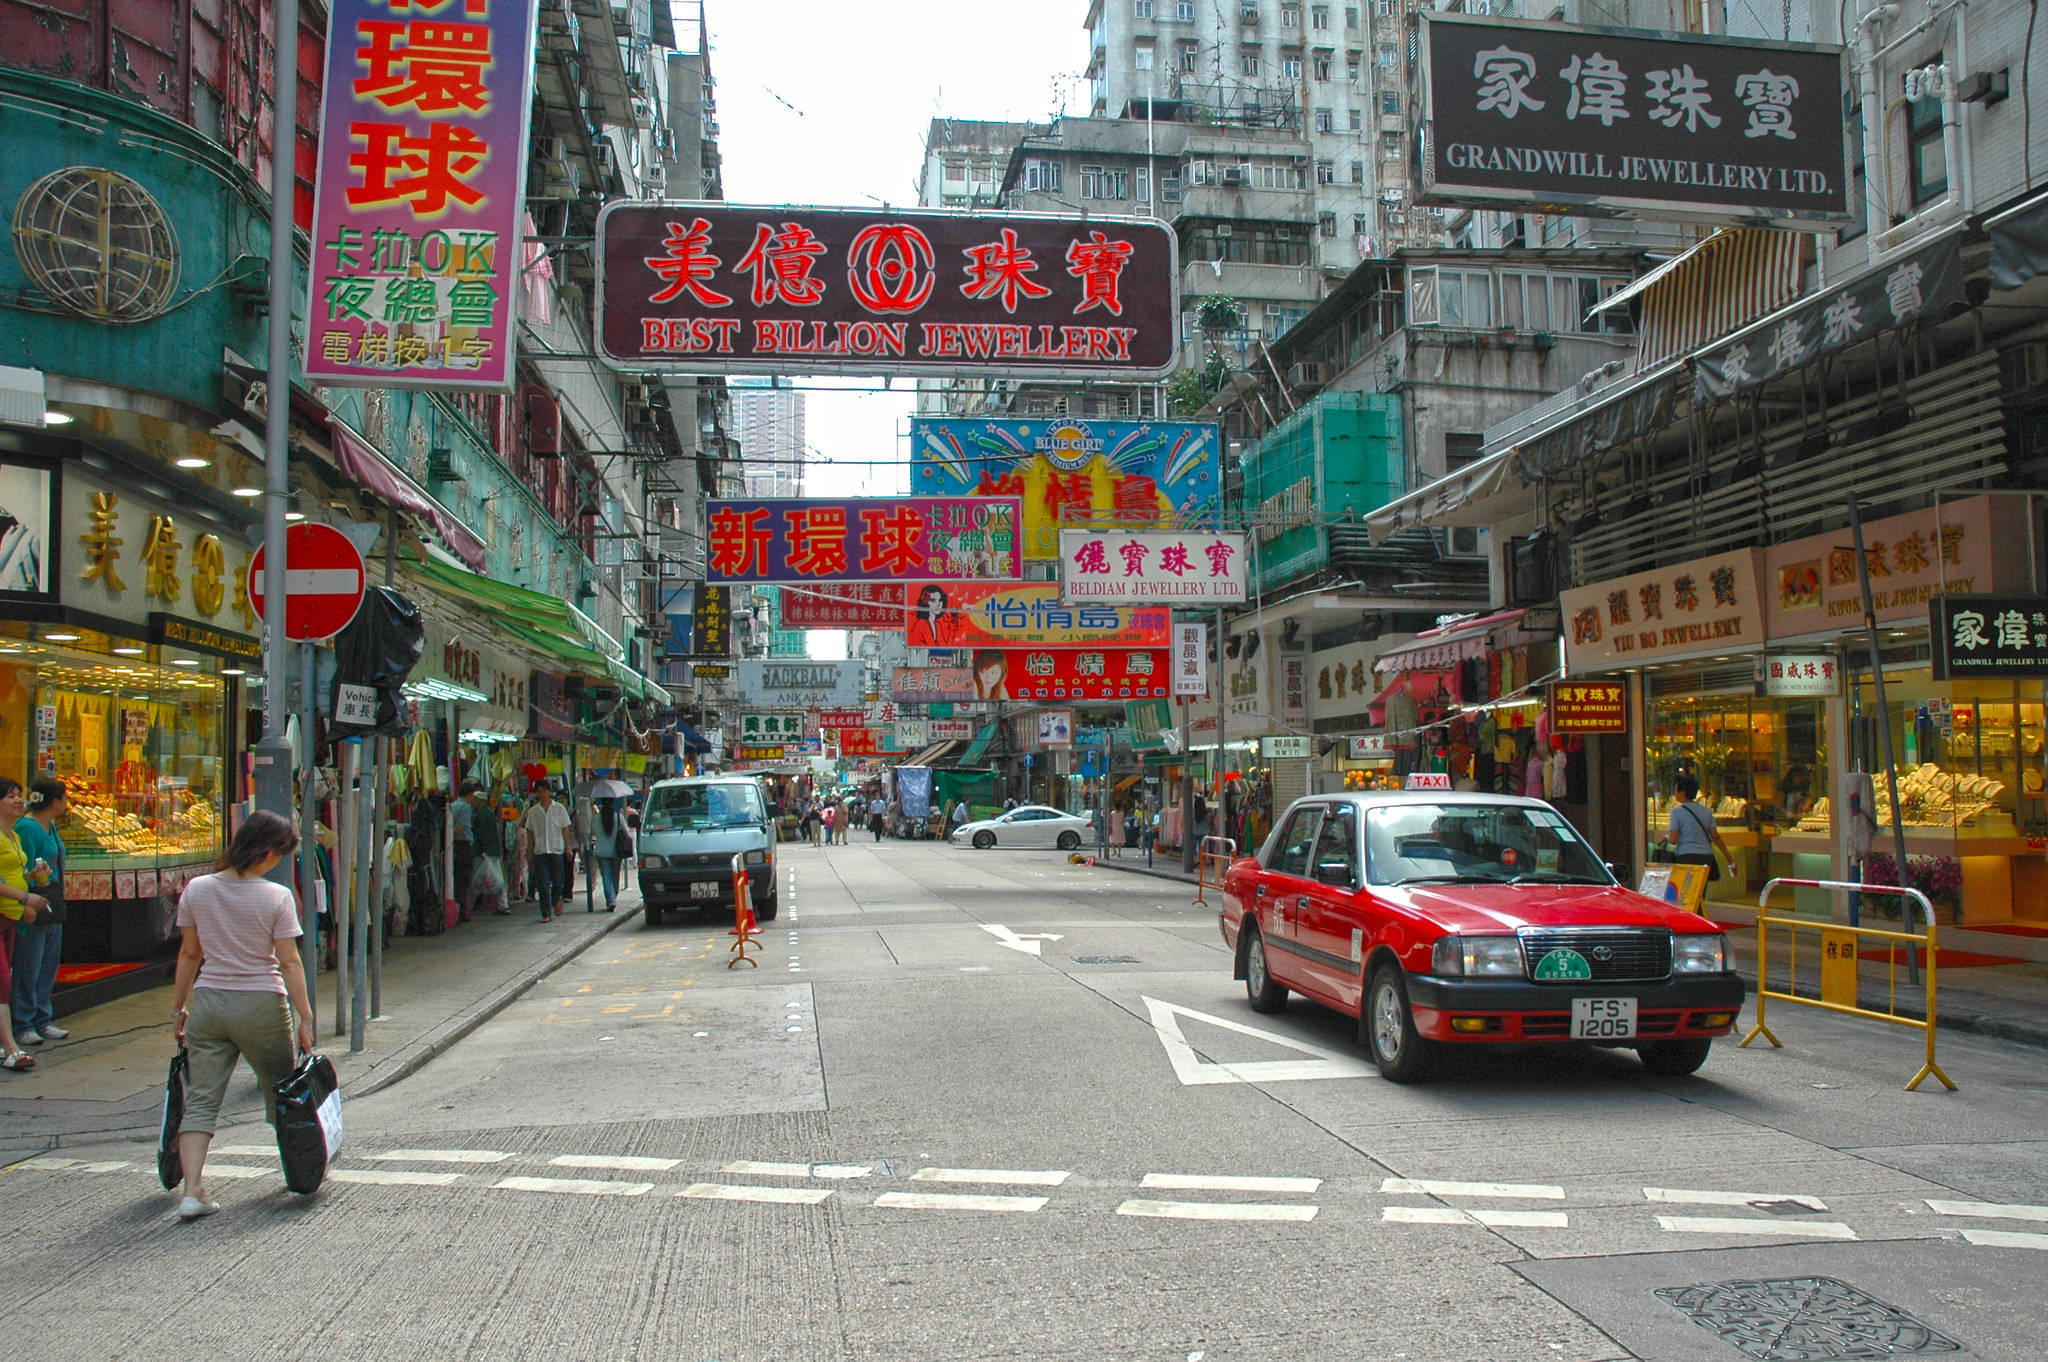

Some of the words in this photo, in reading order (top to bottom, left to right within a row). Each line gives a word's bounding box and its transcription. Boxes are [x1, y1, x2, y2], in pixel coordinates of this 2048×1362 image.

[346, 0, 494, 215] 環球
[1473, 44, 1800, 142] 家偉珠寶
[1446, 143, 1612, 180] GRANDWILL
[1618, 155, 1773, 191] JEWELLERY
[1779, 168, 1834, 197] LTD.
[325, 225, 499, 277] 卡拉OK
[644, 217, 829, 309] 美億
[960, 228, 1135, 317] 珠寶
[324, 275, 499, 328] 夜總會
[641, 318, 741, 353] BEST
[754, 319, 907, 358] BILLION
[920, 322, 1138, 362] JEWELLERY
[1720, 262, 1924, 387] 家偉珠寶
[321, 329, 494, 371] 電梯按1字
[1034, 437, 1069, 450] BLUE
[925, 504, 1013, 528] 卡拉OK
[710, 507, 925, 578] 新環球
[927, 529, 1014, 552] 夜總會
[1070, 581, 1126, 596] BELDIAM
[1132, 581, 1207, 596] JEWELLERY
[1213, 581, 1241, 596] LTD.
[985, 597, 1120, 630] 怡情島
[1952, 609, 2031, 651] 家偉
[1613, 634, 1635, 653] YIU
[1638, 631, 1658, 650] BO
[1661, 616, 1742, 646] JEWELLERY
[1025, 653, 1154, 676] 怡情島
[1952, 657, 1993, 666] GRANDWILL
[1995, 657, 2035, 666] JEWELLERY
[777, 691, 829, 703] ANKARA
[1415, 776, 1448, 787] TAXI
[1550, 951, 1577, 960] TAXI
[1558, 958, 1569, 971] 5
[1590, 1000, 1619, 1018] FS
[1579, 1019, 1629, 1036] 1205
